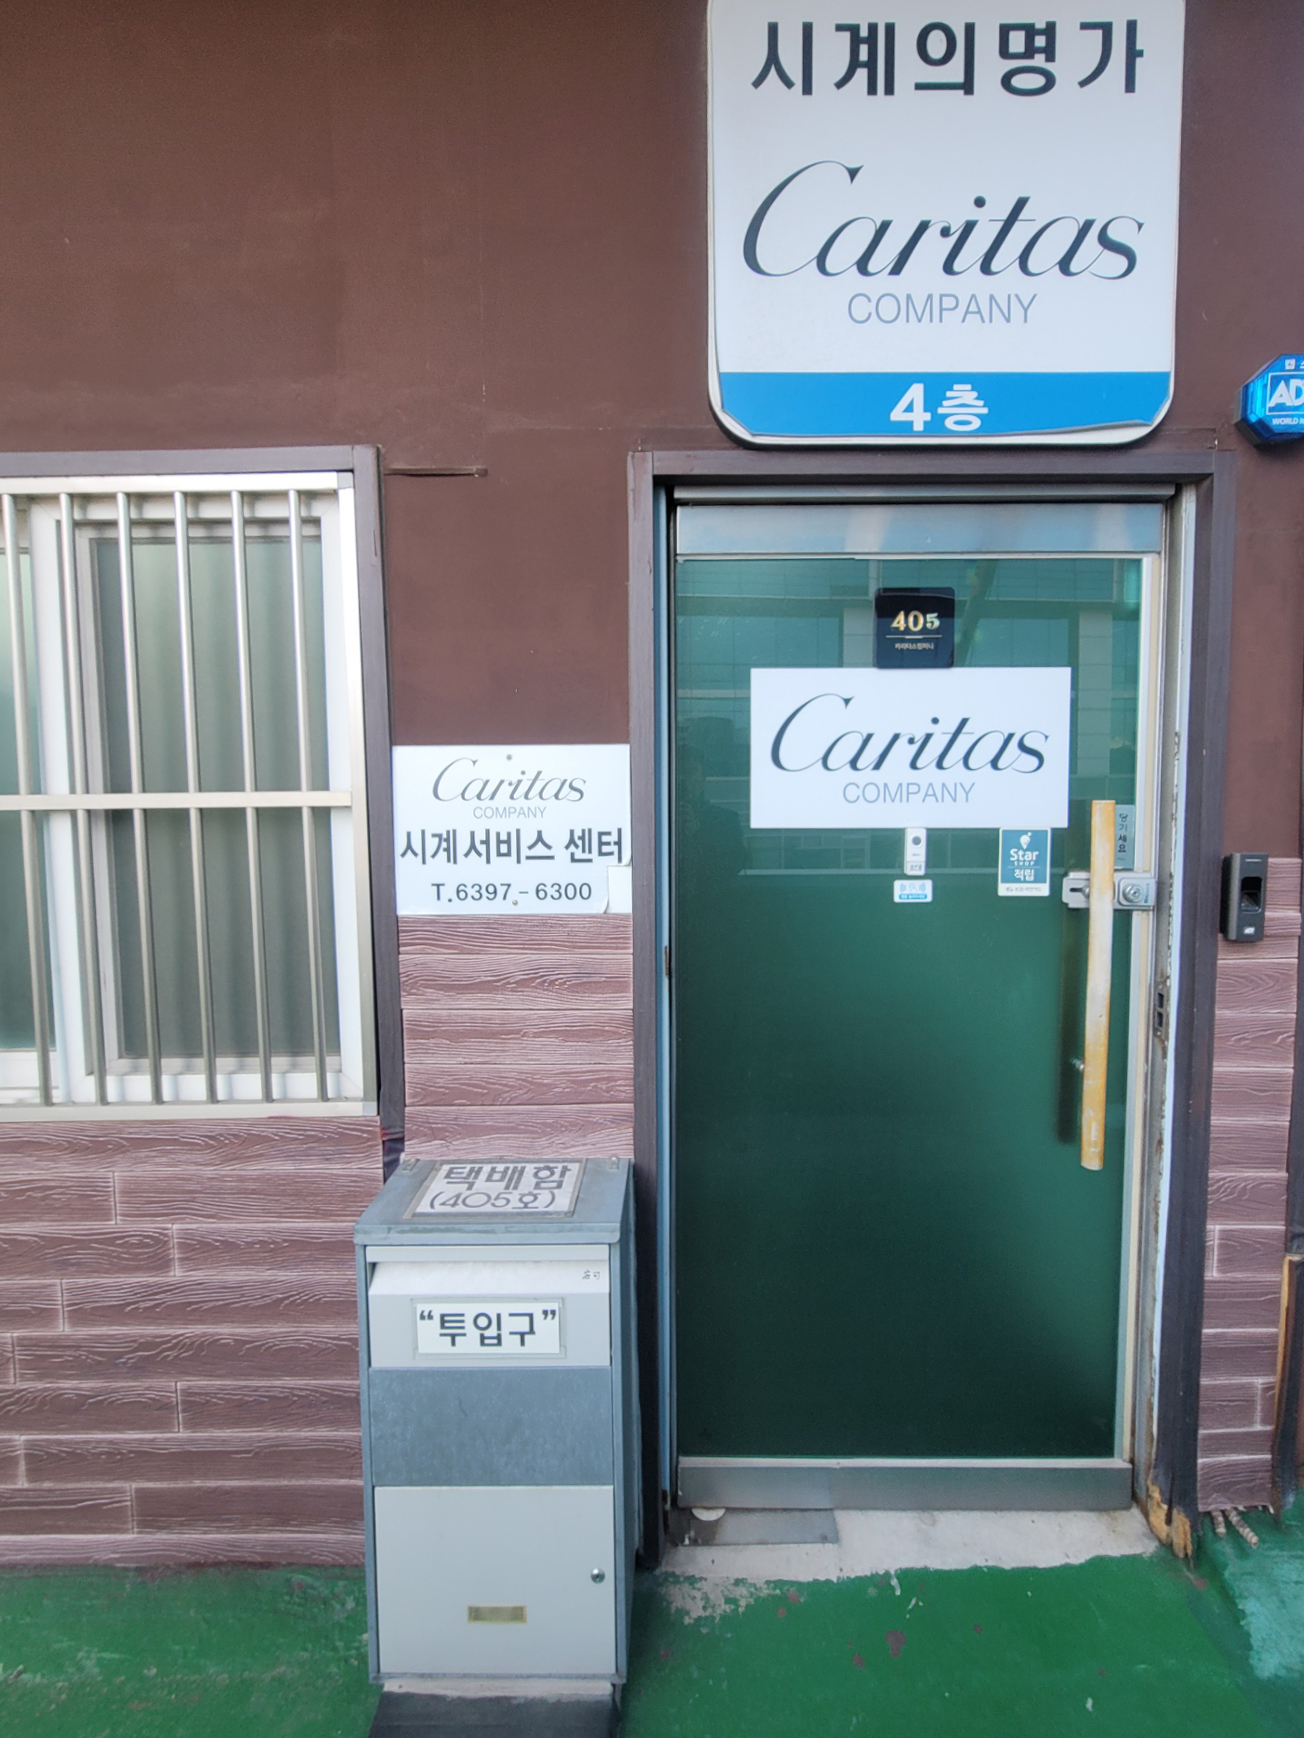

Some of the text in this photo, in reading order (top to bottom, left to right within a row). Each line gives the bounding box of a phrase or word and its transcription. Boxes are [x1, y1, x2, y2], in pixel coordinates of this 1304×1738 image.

[751, 19, 1144, 97] 시계의명가
[742, 160, 1145, 281] Caritas
[847, 292, 1037, 324] COMPANY
[889, 382, 989, 432] 4층
[1272, 417, 1299, 425] WORLD
[890, 610, 941, 632] 405
[770, 693, 1050, 774] Caritas
[432, 757, 587, 803] Caritas
[842, 781, 976, 804] COMPANY
[473, 806, 547, 819] COMPANY
[564, 827, 623, 864] 센터
[1117, 813, 1128, 853] 당기세요
[1010, 848, 1039, 861] Star
[1014, 868, 1035, 881] 적립
[443, 1164, 571, 1191] 택배함
[429, 1191, 556, 1210] (405호)
